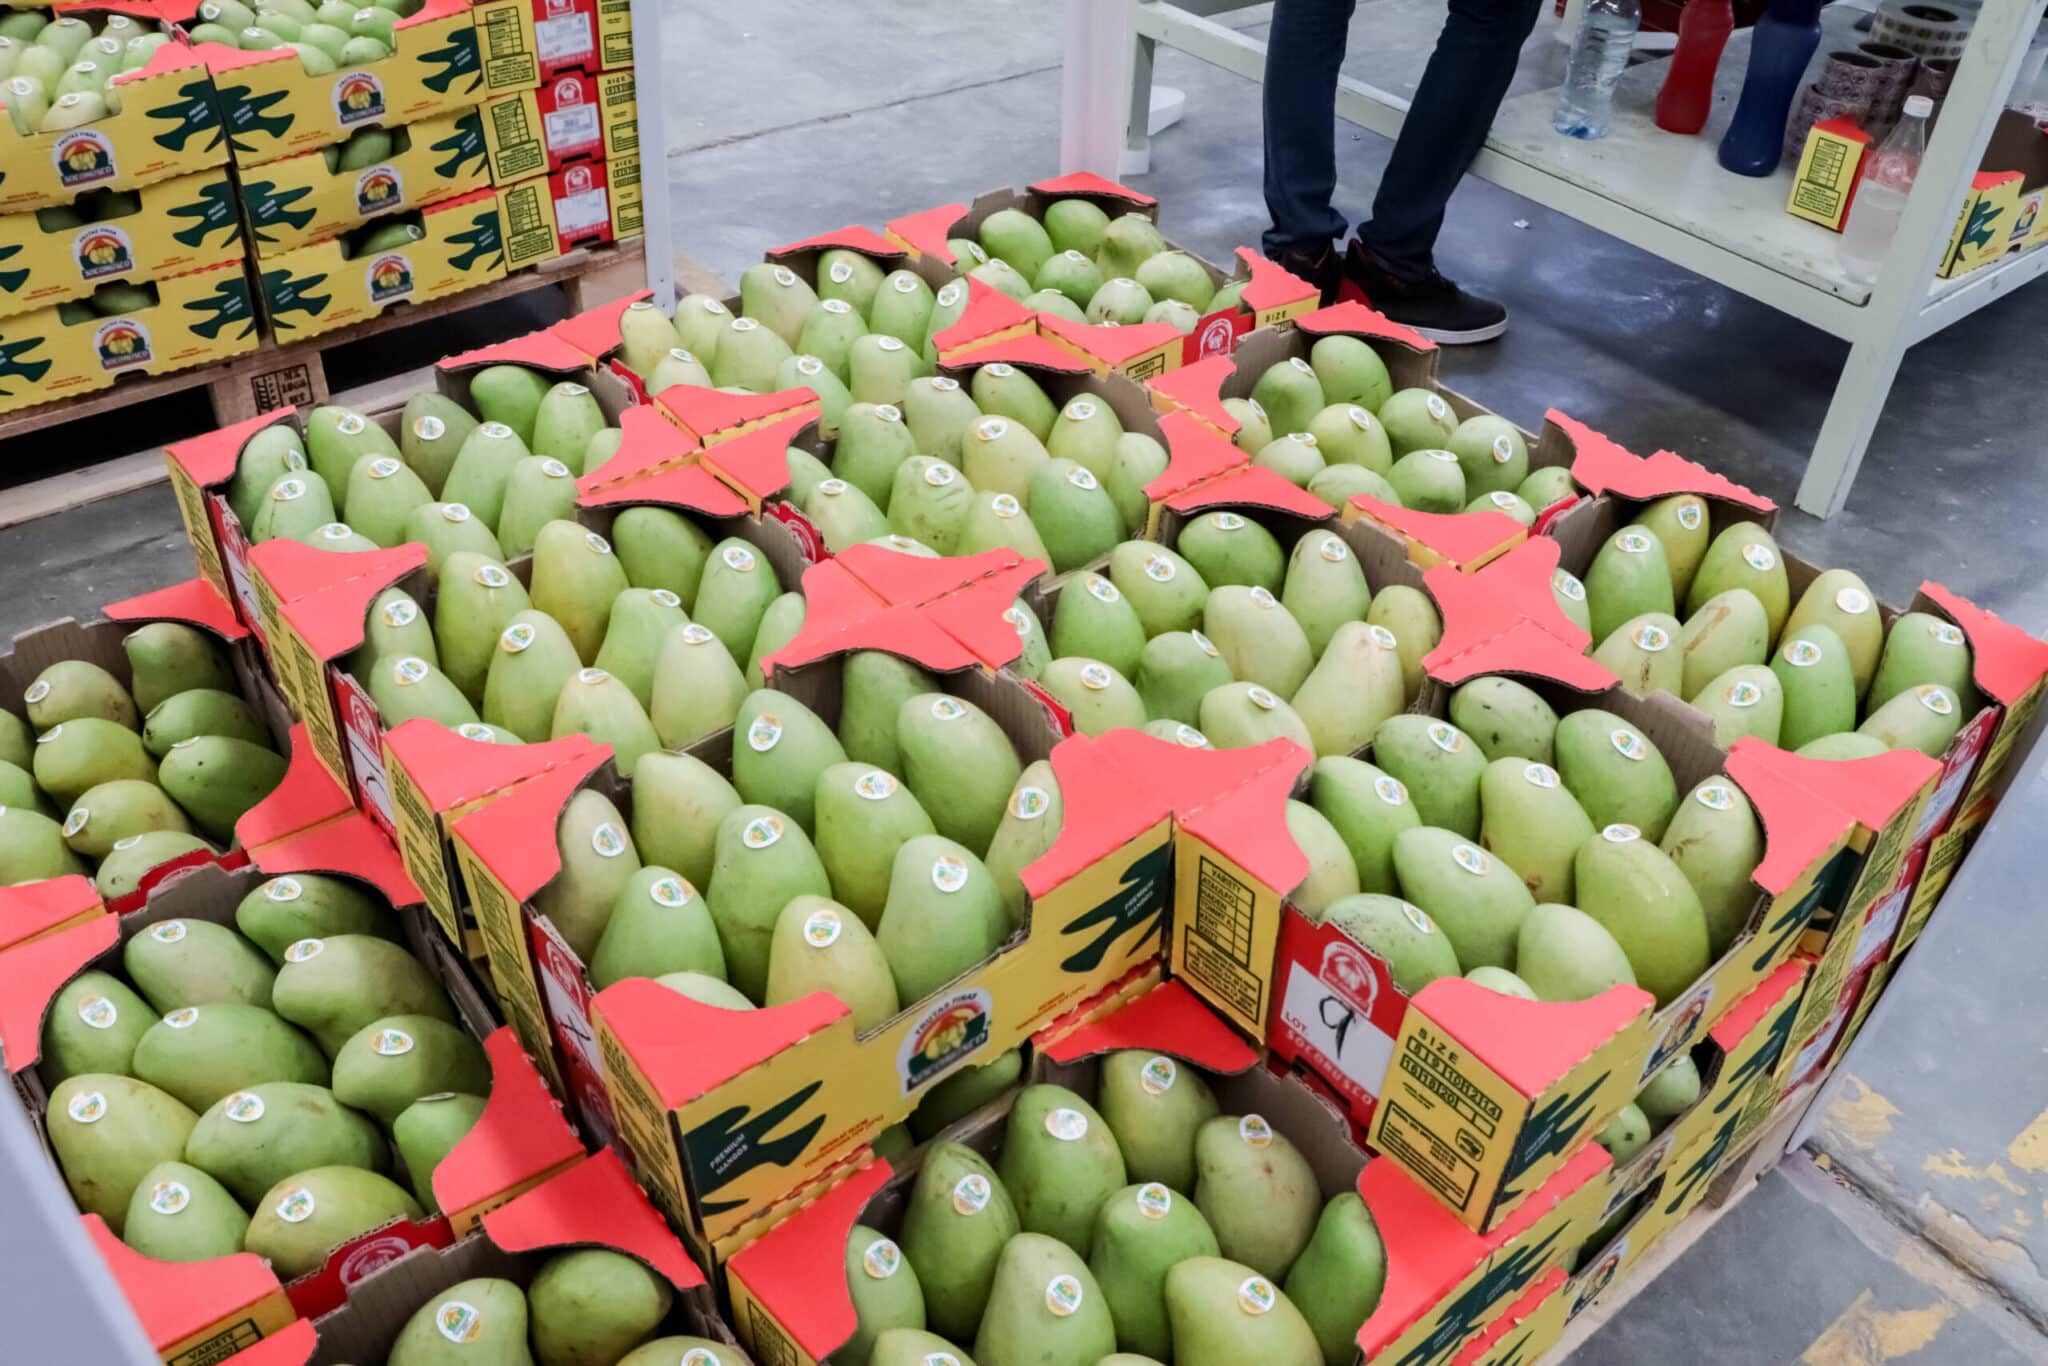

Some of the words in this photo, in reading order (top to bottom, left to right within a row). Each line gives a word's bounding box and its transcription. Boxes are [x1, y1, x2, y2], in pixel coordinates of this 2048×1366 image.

[1211, 868, 1241, 893] VARIETY
[1285, 1011, 1309, 1036] LOT
[1318, 995, 1357, 1060] 9
[1418, 1027, 1459, 1066] SIZE
[1286, 1030, 1374, 1106] SOCONUSCO
[1440, 1087, 1456, 1105] 20
[1447, 1070, 1462, 1087] 10
[1463, 1082, 1479, 1102] 12
[709, 1132, 745, 1169] PREMIUM
[716, 1143, 749, 1176] MANGOS
[187, 1332, 234, 1360] VARIETY
